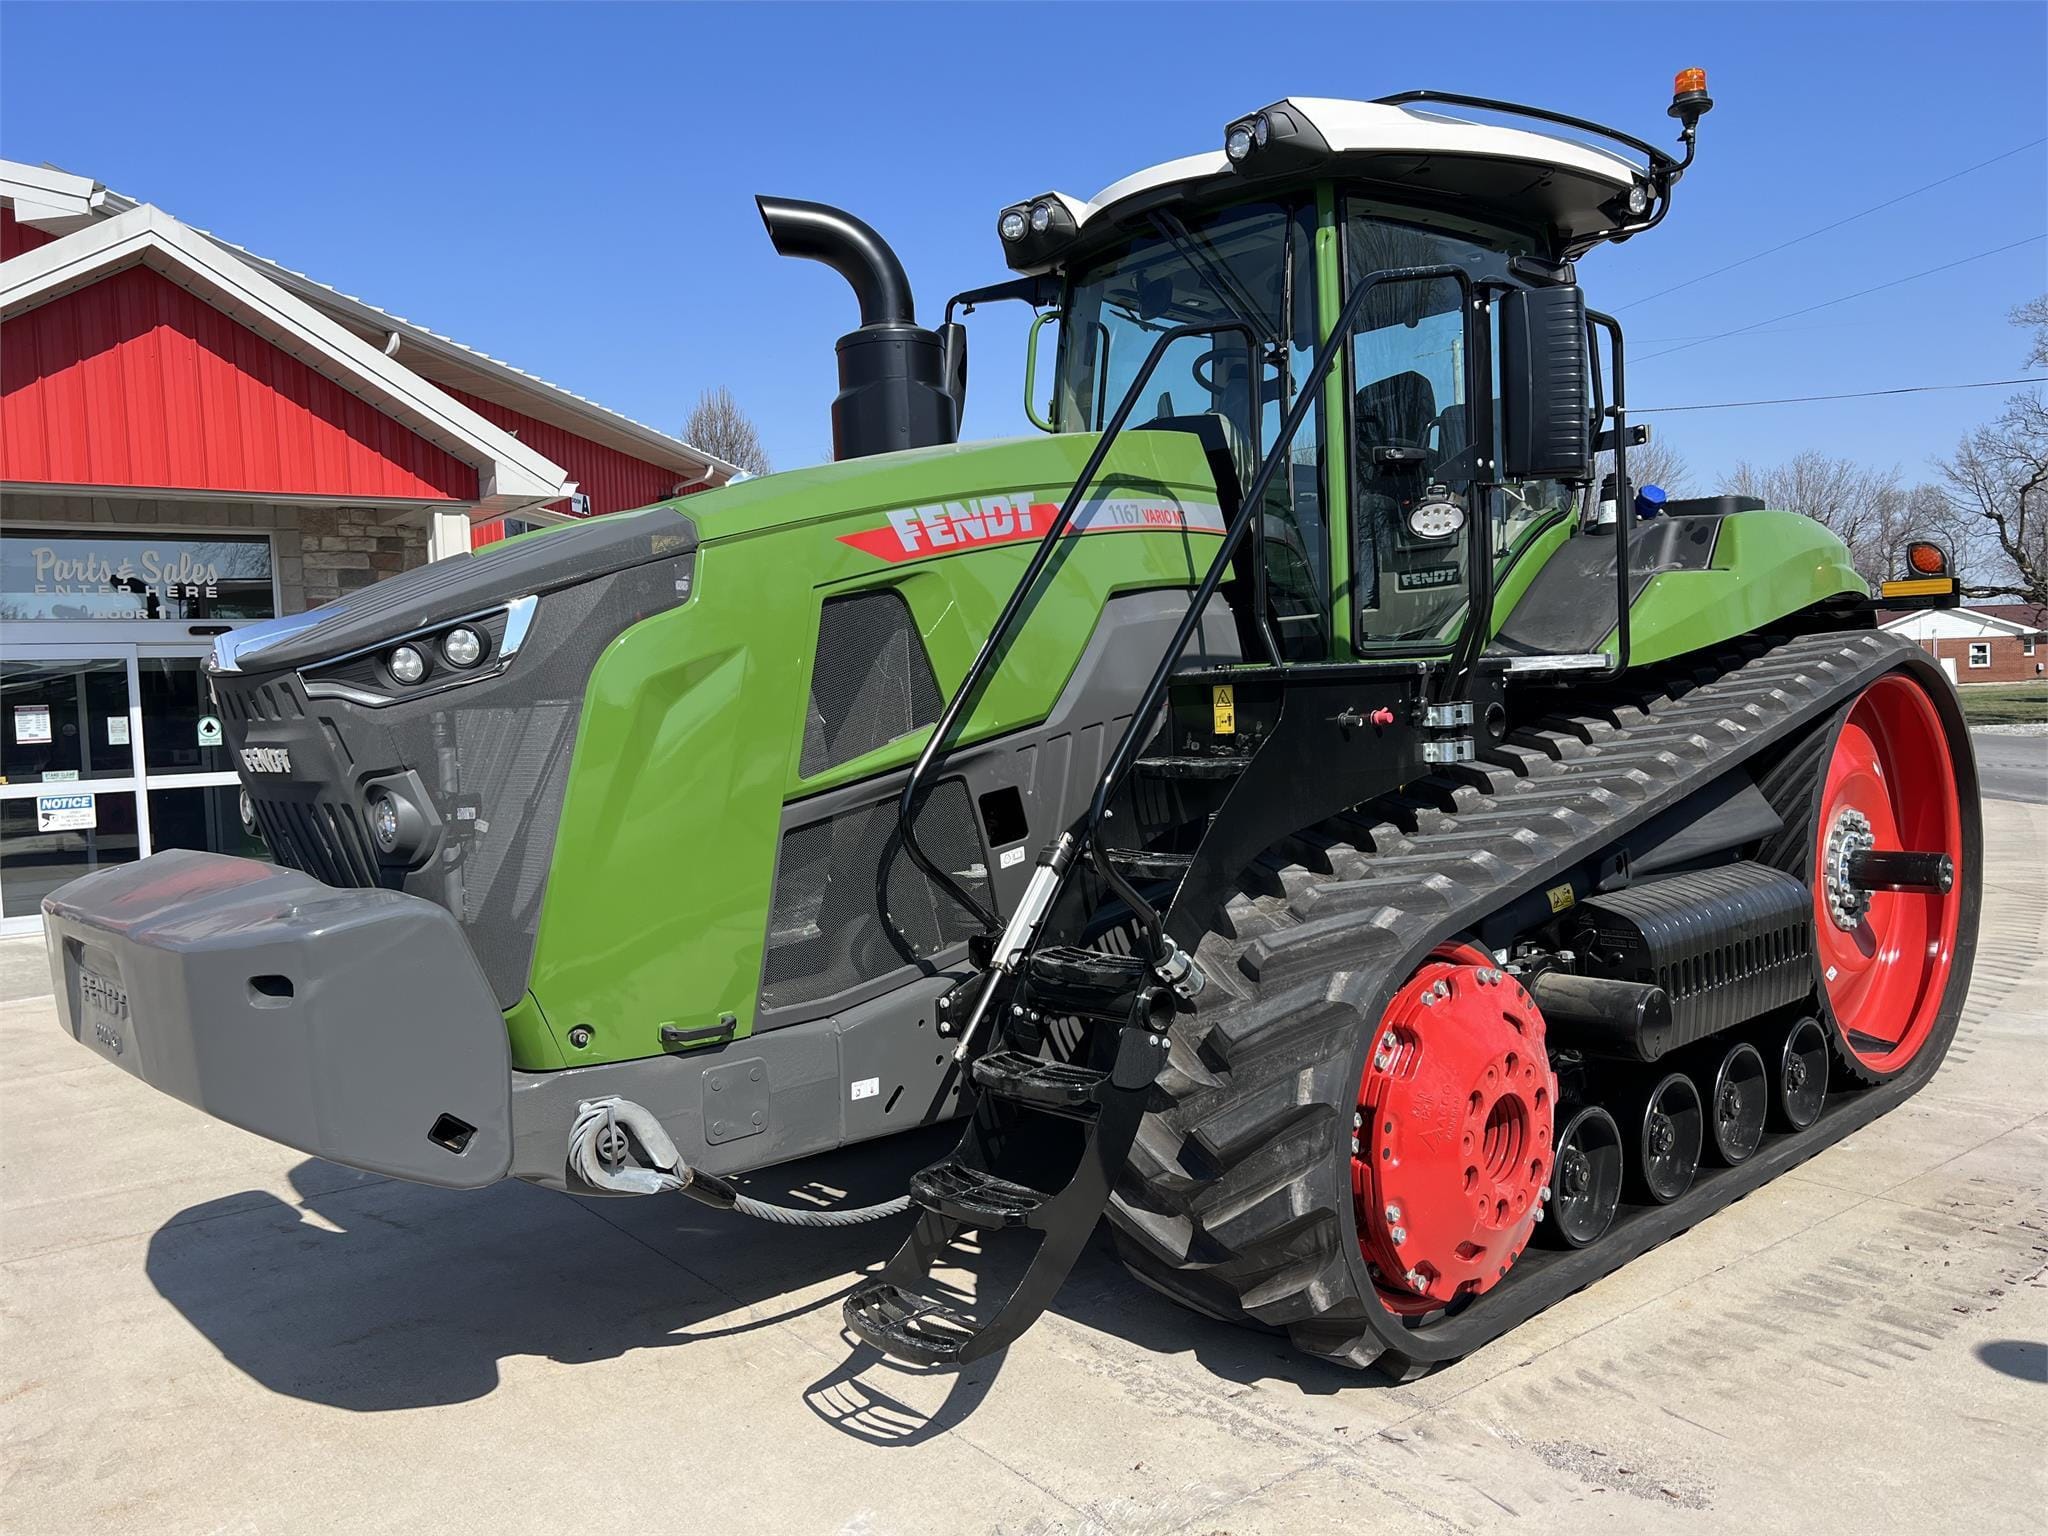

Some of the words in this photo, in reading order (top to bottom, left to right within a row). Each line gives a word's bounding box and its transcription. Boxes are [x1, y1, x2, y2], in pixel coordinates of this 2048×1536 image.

[582, 495, 589, 515] A
[1108, 504, 1139, 525] 1167
[1141, 508, 1172, 525] VARIO
[886, 493, 1034, 552] FENDT
[32, 546, 112, 582] Parts
[117, 557, 137, 584] &
[141, 550, 218, 585] Sales
[1401, 569, 1457, 586] FENDT
[34, 585, 132, 597] ENTER
[145, 585, 218, 598] HERE
[156, 606, 167, 619] 1
[240, 748, 291, 773] FENDT
[41, 797, 91, 810] NOTICE
